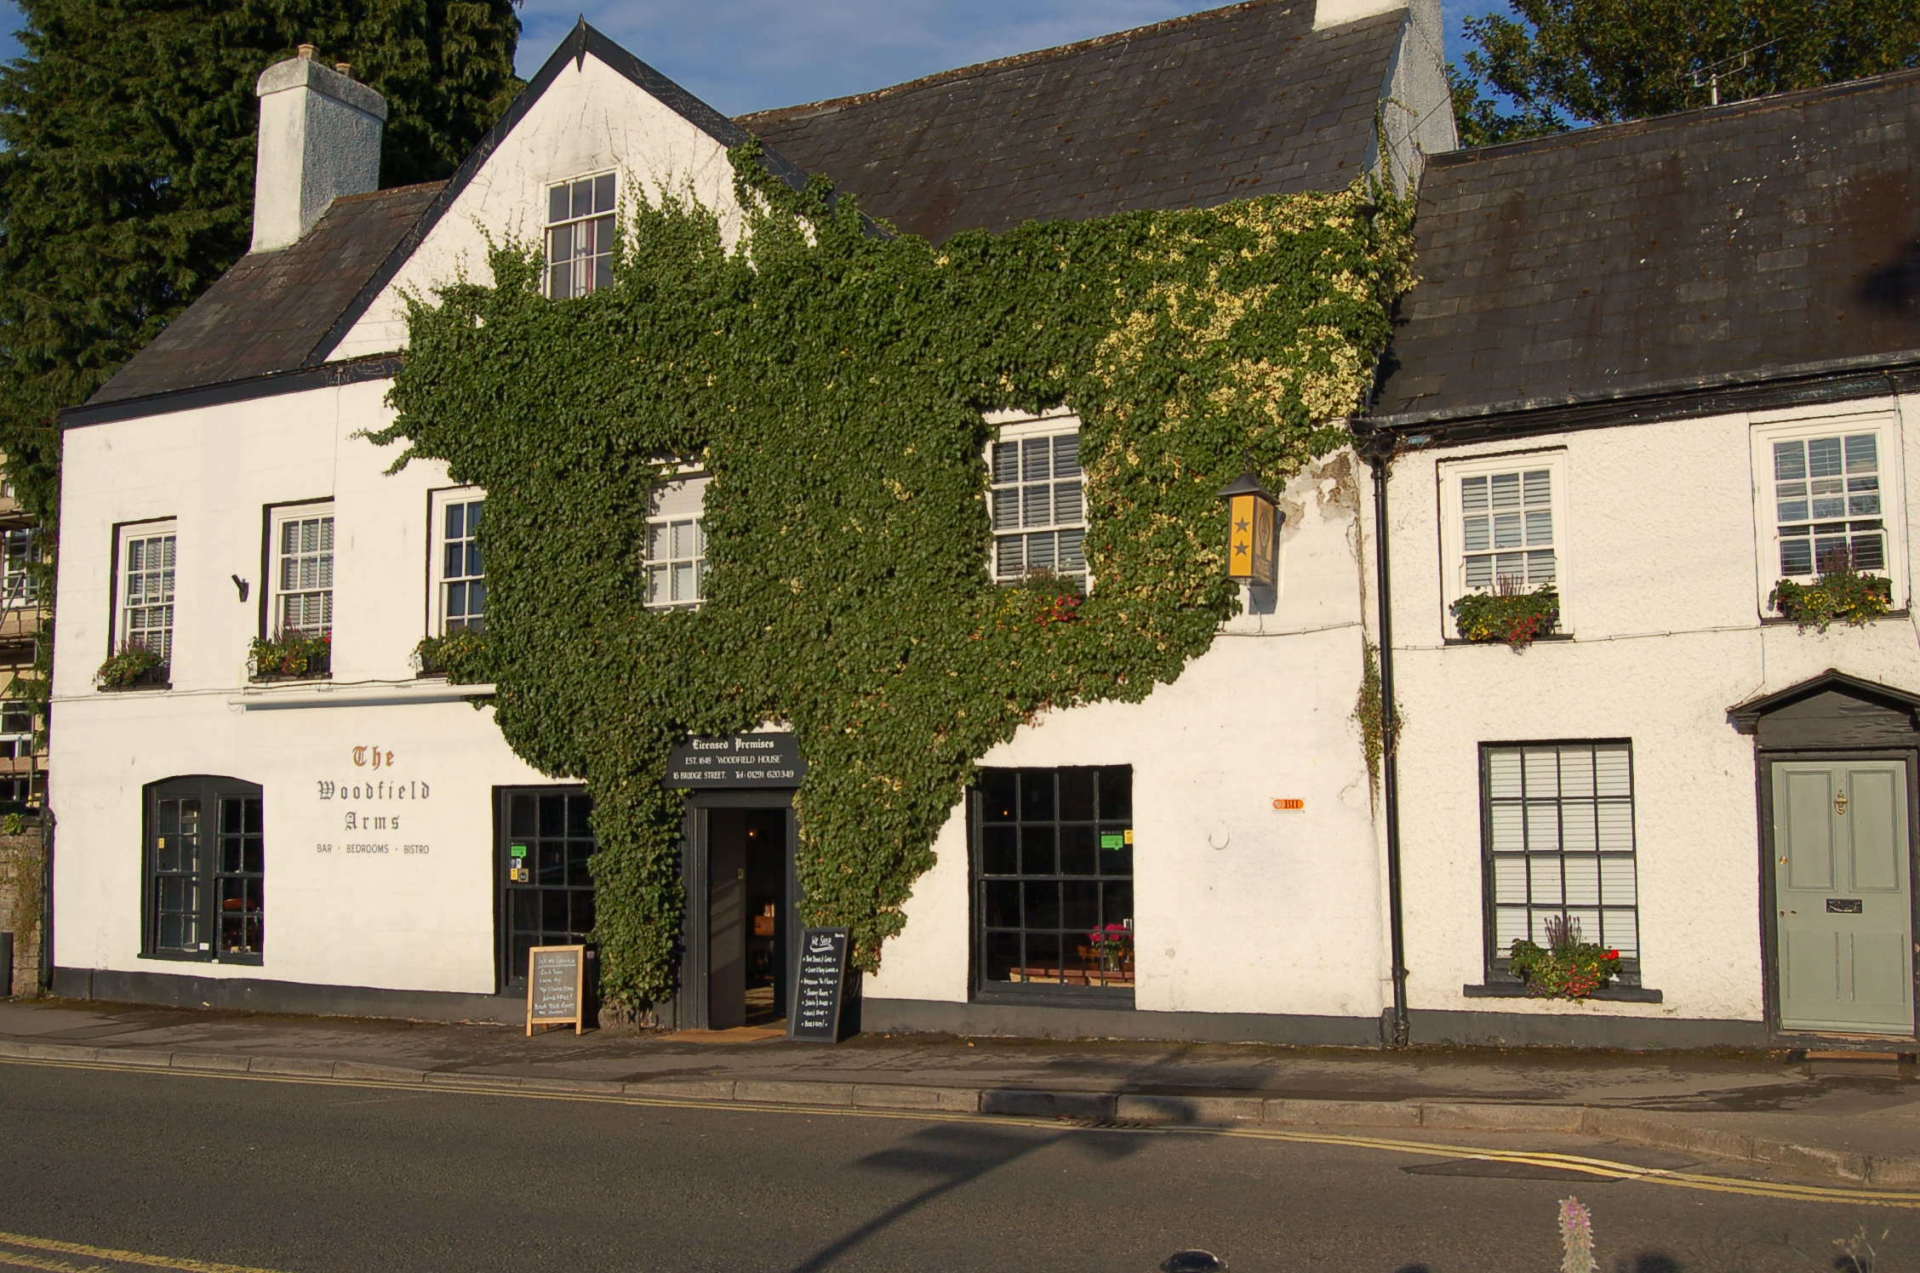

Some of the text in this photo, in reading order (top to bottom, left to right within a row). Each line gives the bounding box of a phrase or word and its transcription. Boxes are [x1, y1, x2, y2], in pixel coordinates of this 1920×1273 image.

[692, 737, 775, 752] Licensed Premises
[352, 745, 395, 770] The
[680, 771, 703, 780] BRIDGE
[317, 780, 431, 801] Woodfield
[344, 811, 400, 831] Arms
[316, 843, 430, 855] BAR BEDROOMS BISTRO
